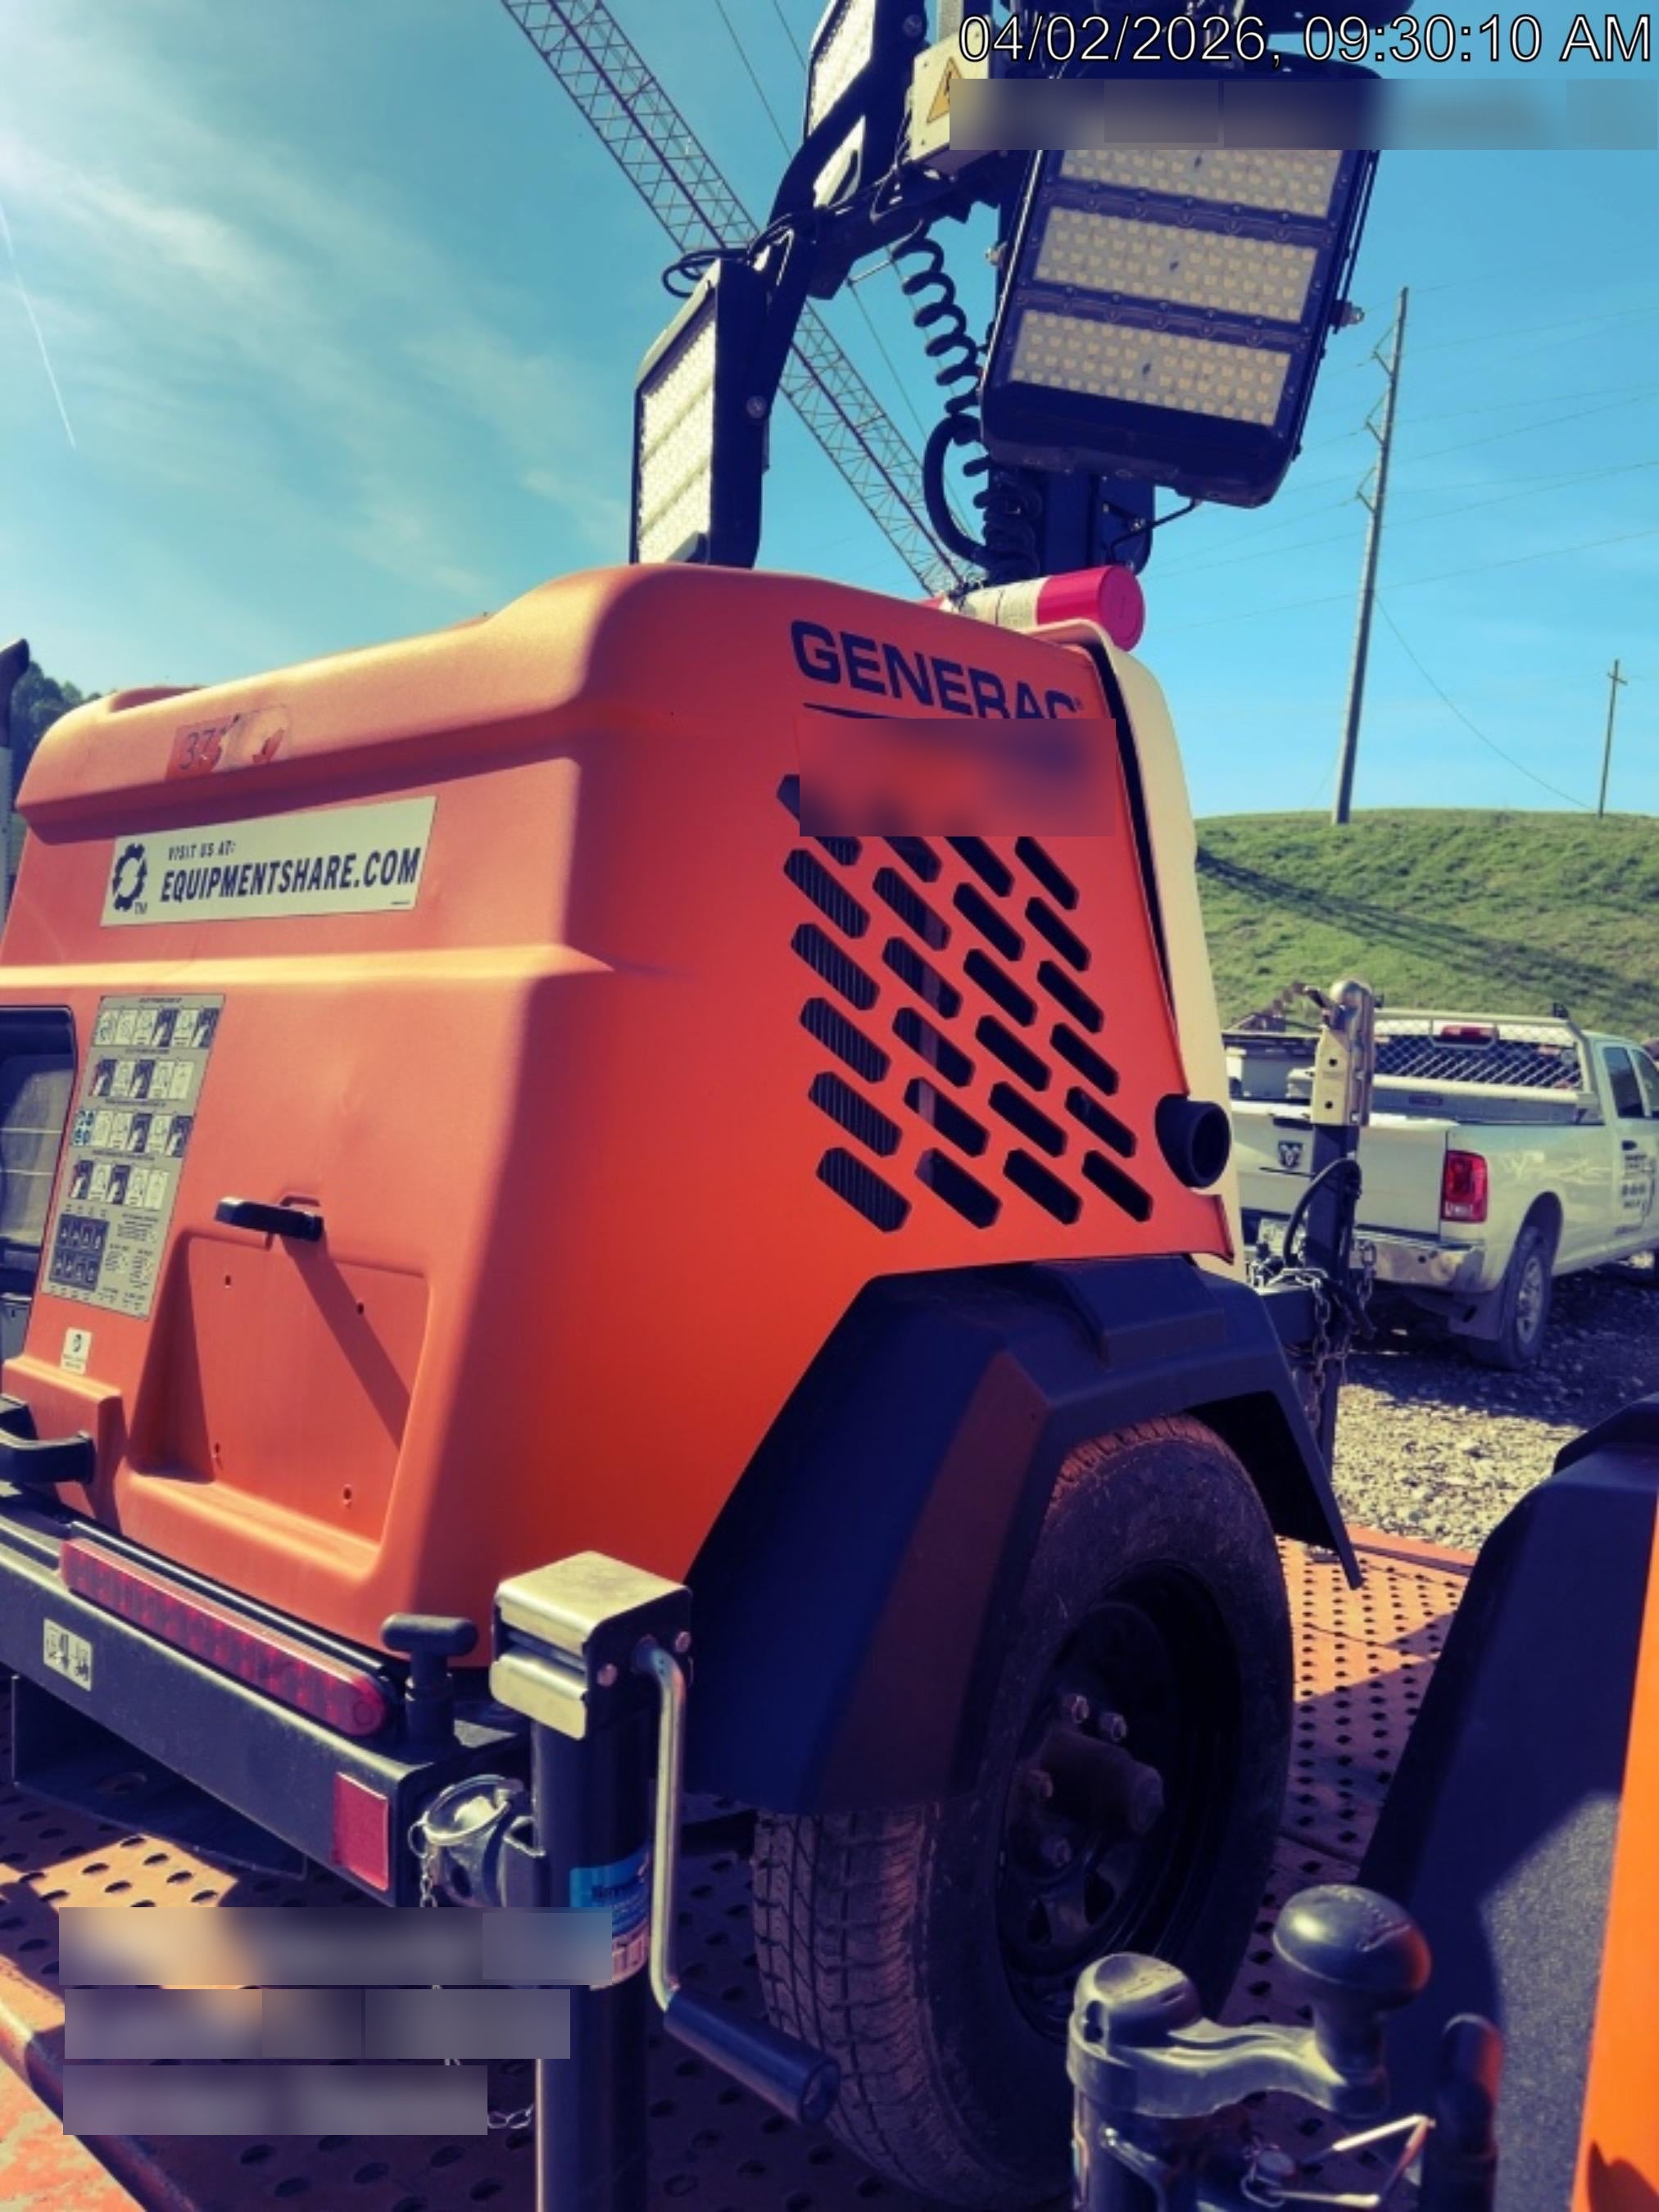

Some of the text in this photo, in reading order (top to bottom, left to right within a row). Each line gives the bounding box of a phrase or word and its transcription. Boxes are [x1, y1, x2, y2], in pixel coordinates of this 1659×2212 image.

[168, 840, 235, 860] VISIT US AT:
[160, 847, 421, 903] EQUIPMENTSHARE.COM
